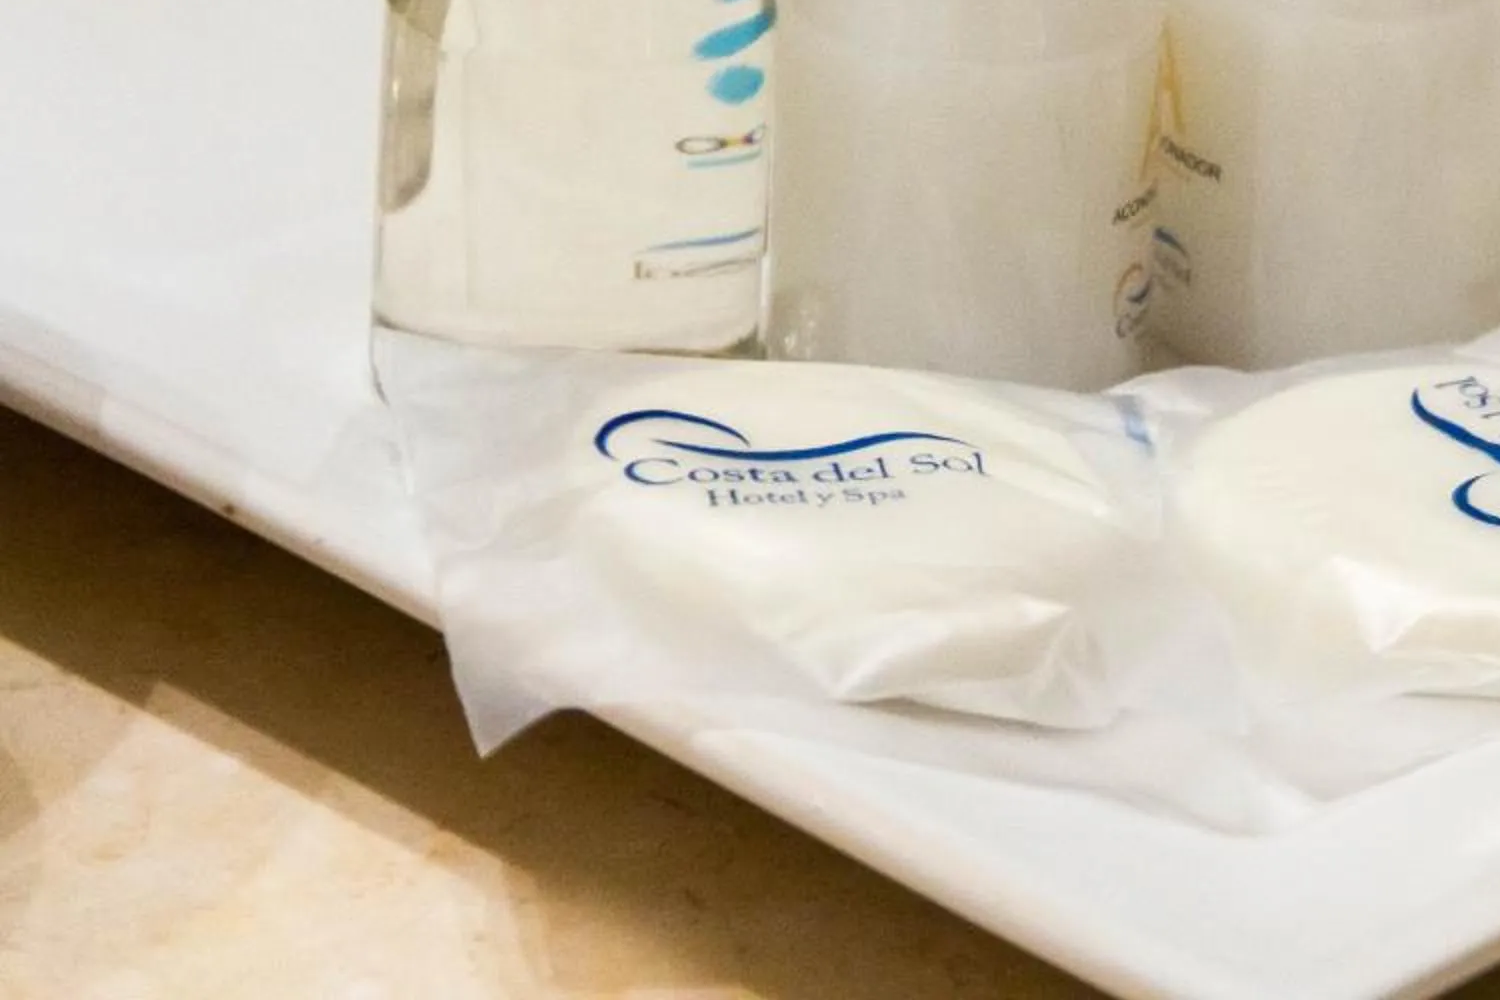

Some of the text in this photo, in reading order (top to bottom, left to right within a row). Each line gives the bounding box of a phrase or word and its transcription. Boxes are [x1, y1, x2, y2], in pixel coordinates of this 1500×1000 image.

[624, 451, 991, 485] Costa del Sol
[706, 487, 907, 509] Hotel y Spa
